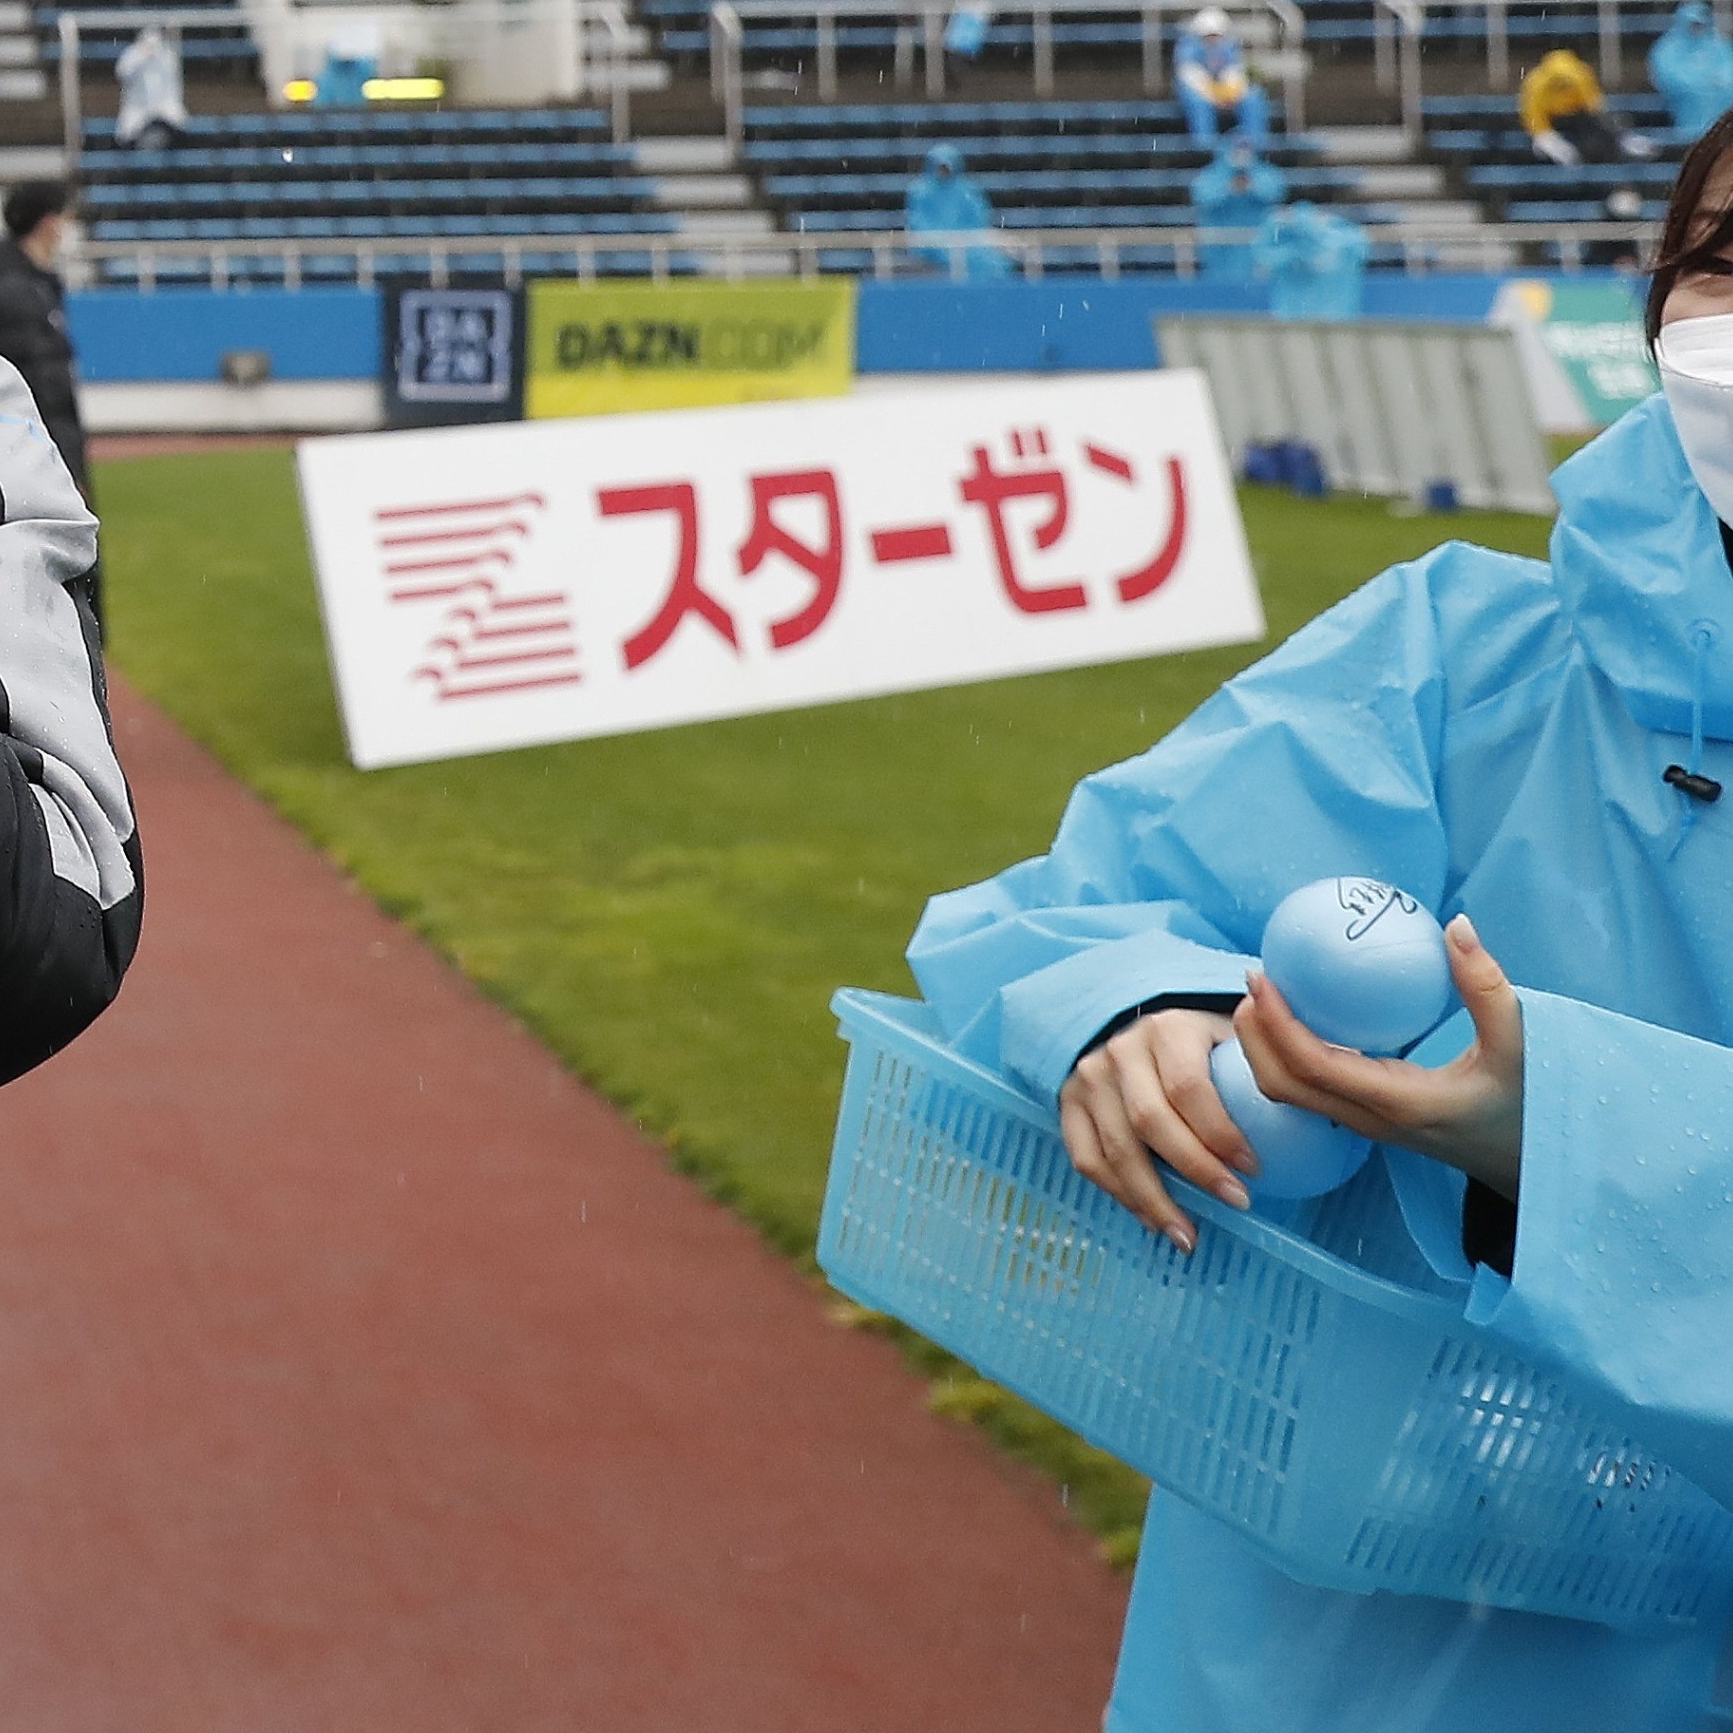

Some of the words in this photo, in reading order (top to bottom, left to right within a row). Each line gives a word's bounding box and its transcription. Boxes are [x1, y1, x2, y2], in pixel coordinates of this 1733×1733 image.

[595, 426, 1190, 672] スターゼン
